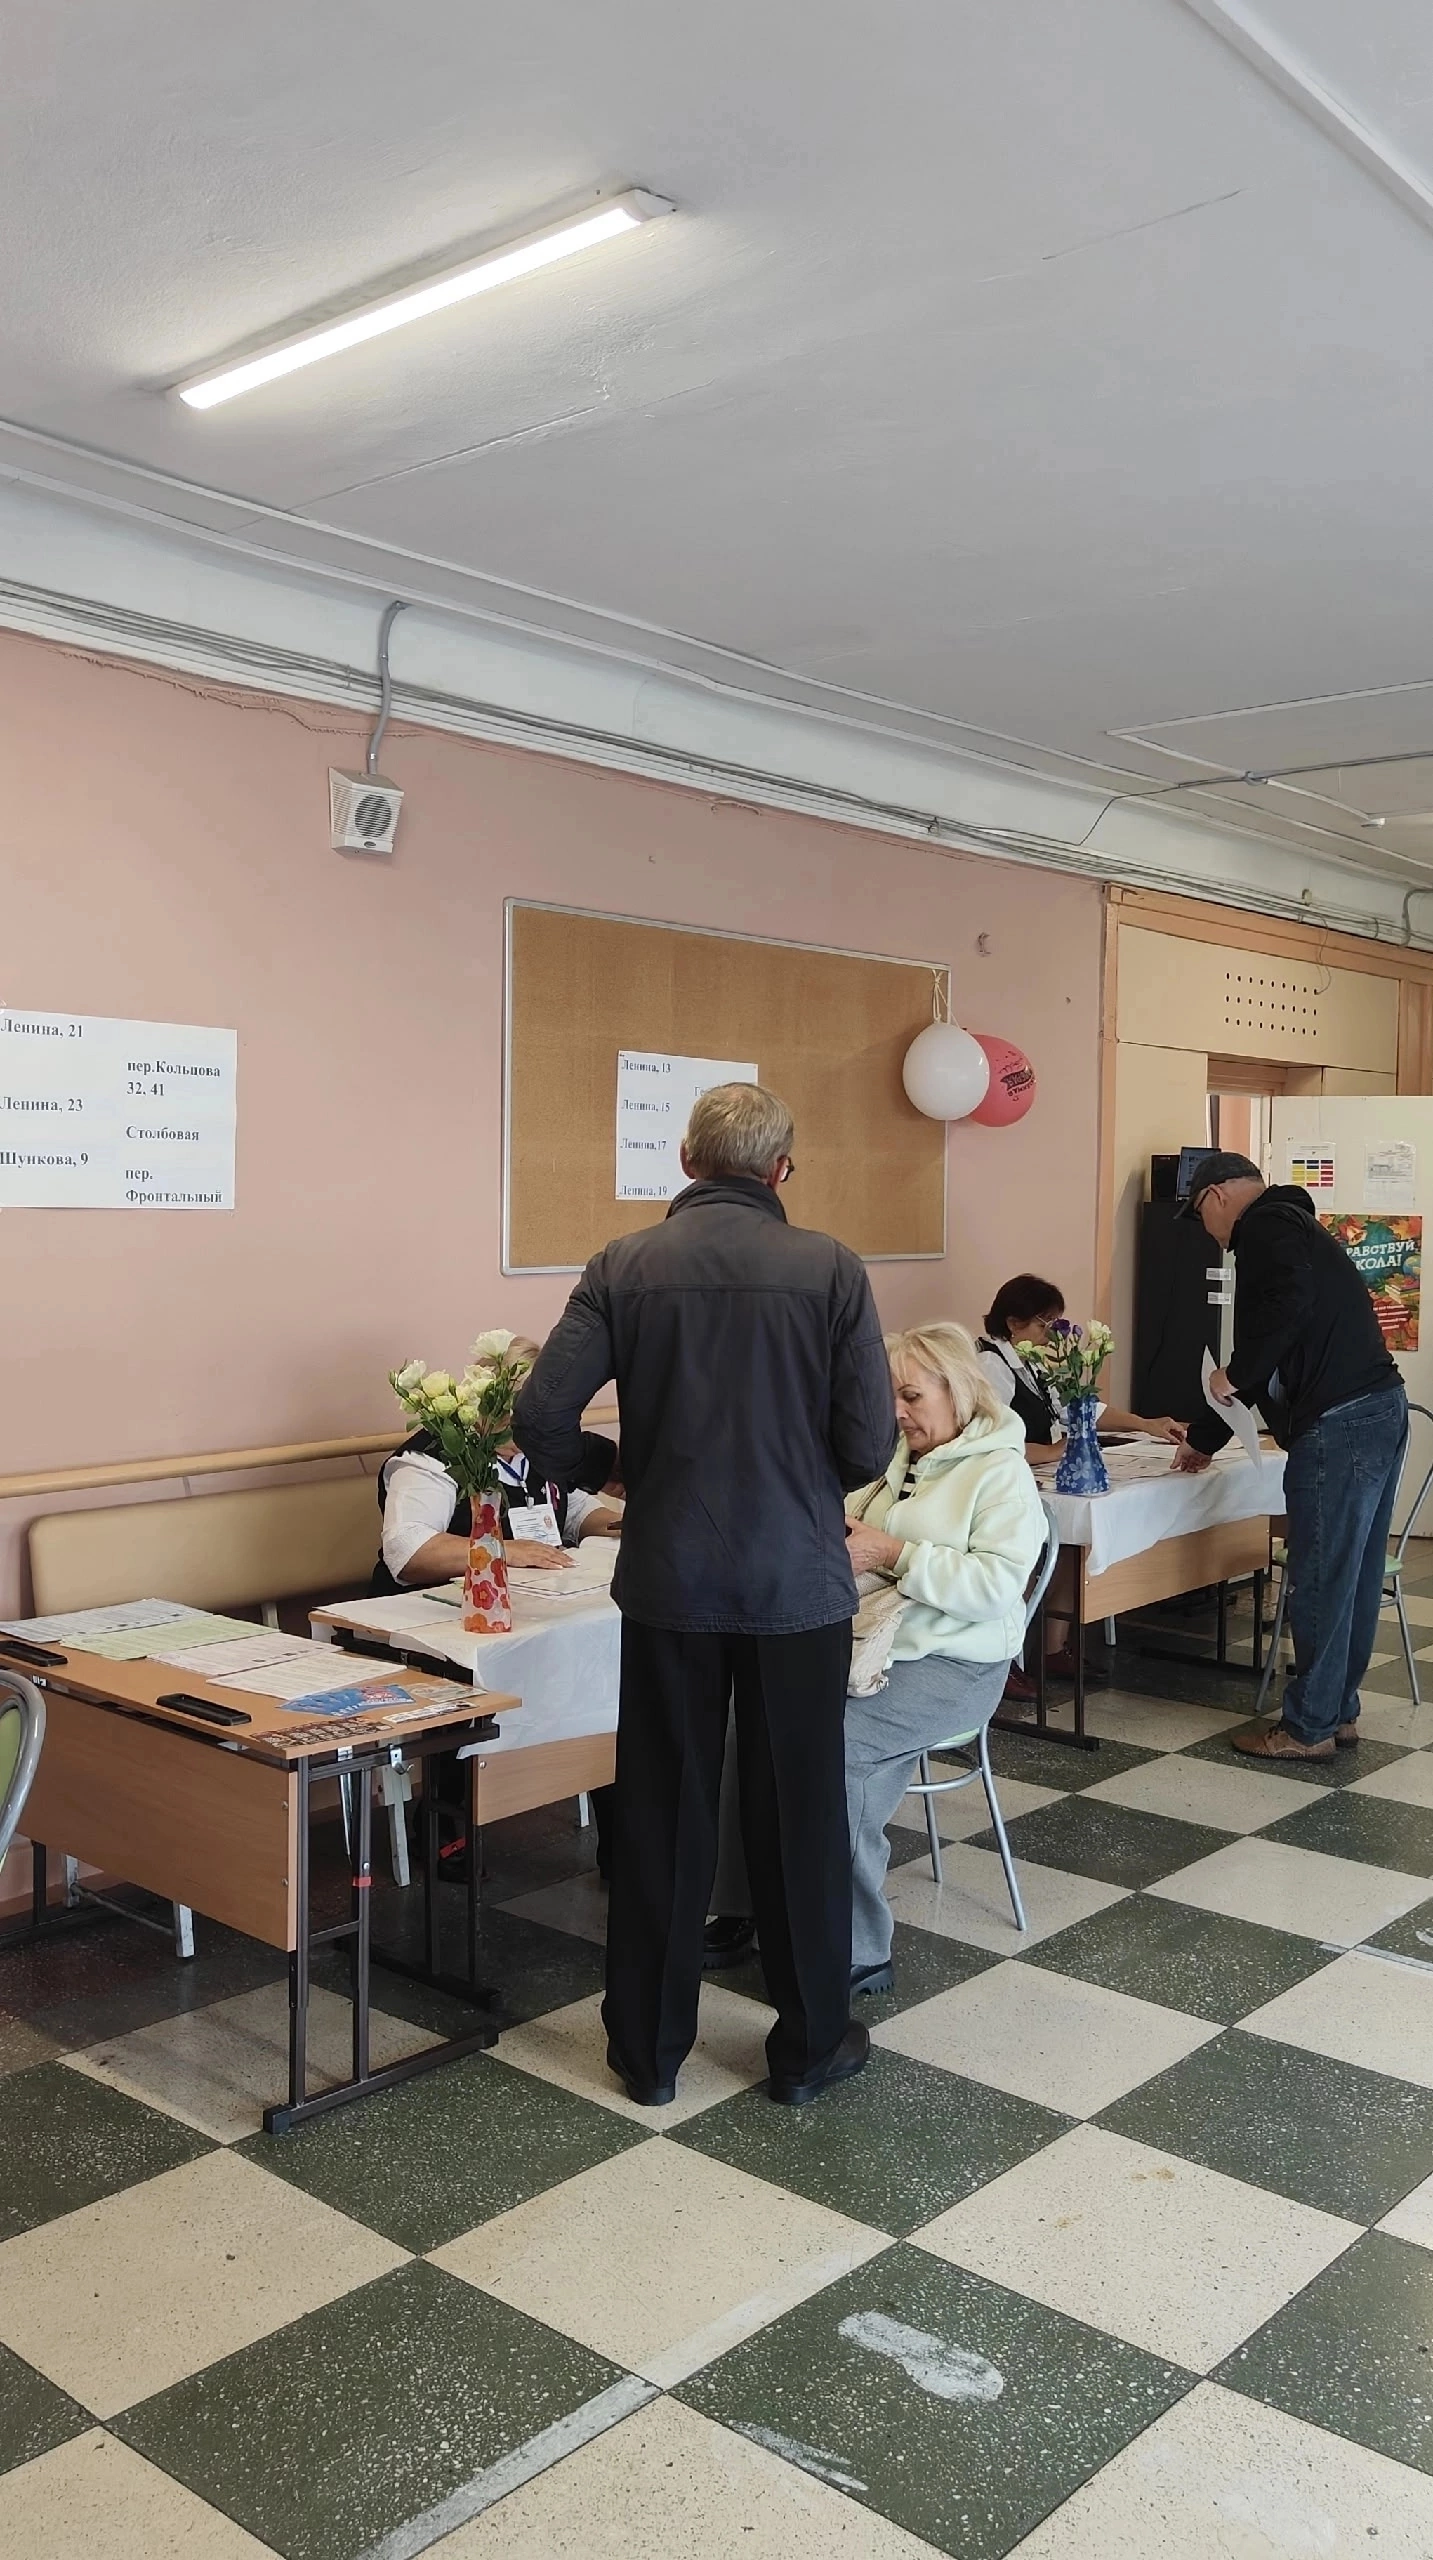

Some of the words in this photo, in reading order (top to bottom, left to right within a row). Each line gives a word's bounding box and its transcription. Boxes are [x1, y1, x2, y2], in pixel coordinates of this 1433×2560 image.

[1, 1018, 64, 1039] Ленина,
[68, 1024, 83, 1038] 21
[127, 1060, 221, 1077] пер.Кольцова
[662, 1062, 671, 1074] 13
[150, 1083, 165, 1096] 41
[0, 1096, 63, 1113] Ленина,
[67, 1098, 84, 1112] 23
[660, 1102, 671, 1113] 15
[125, 1125, 200, 1141] Столбовая
[0, 1151, 77, 1168] Шункова,
[80, 1152, 89, 1165] 9
[125, 1169, 153, 1182] пер.
[125, 1189, 223, 1205] Фронтальный
[658, 1185, 668, 1196] 19
[1355, 1253, 1403, 1271] КОЛА!
